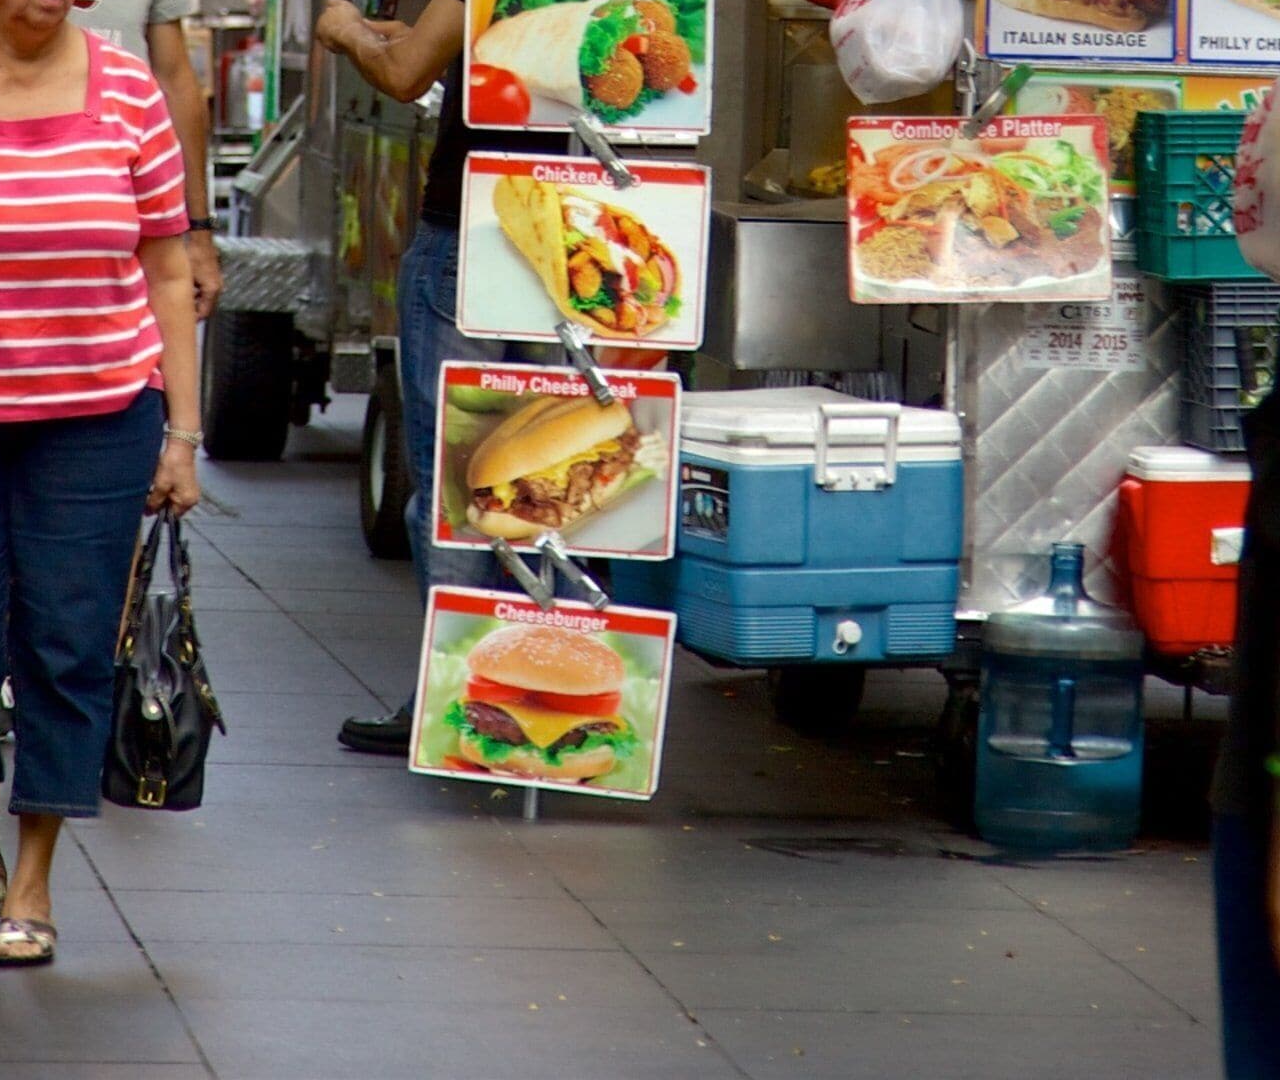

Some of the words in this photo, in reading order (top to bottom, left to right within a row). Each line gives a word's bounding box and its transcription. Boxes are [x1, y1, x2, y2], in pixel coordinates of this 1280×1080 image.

[1002, 30, 1066, 48] ITALIAN
[1071, 32, 1148, 49] SAUSAGE
[1199, 35, 1254, 53] PHILLY
[891, 122, 957, 138] Combo
[1002, 120, 1062, 136] Platter
[532, 165, 598, 185] Chicken
[1047, 331, 1083, 349] 2014
[1091, 333, 1128, 350] 2015
[480, 373, 526, 396] Philly
[529, 376, 589, 396] Cheese
[494, 602, 609, 633] Cheeseburger
